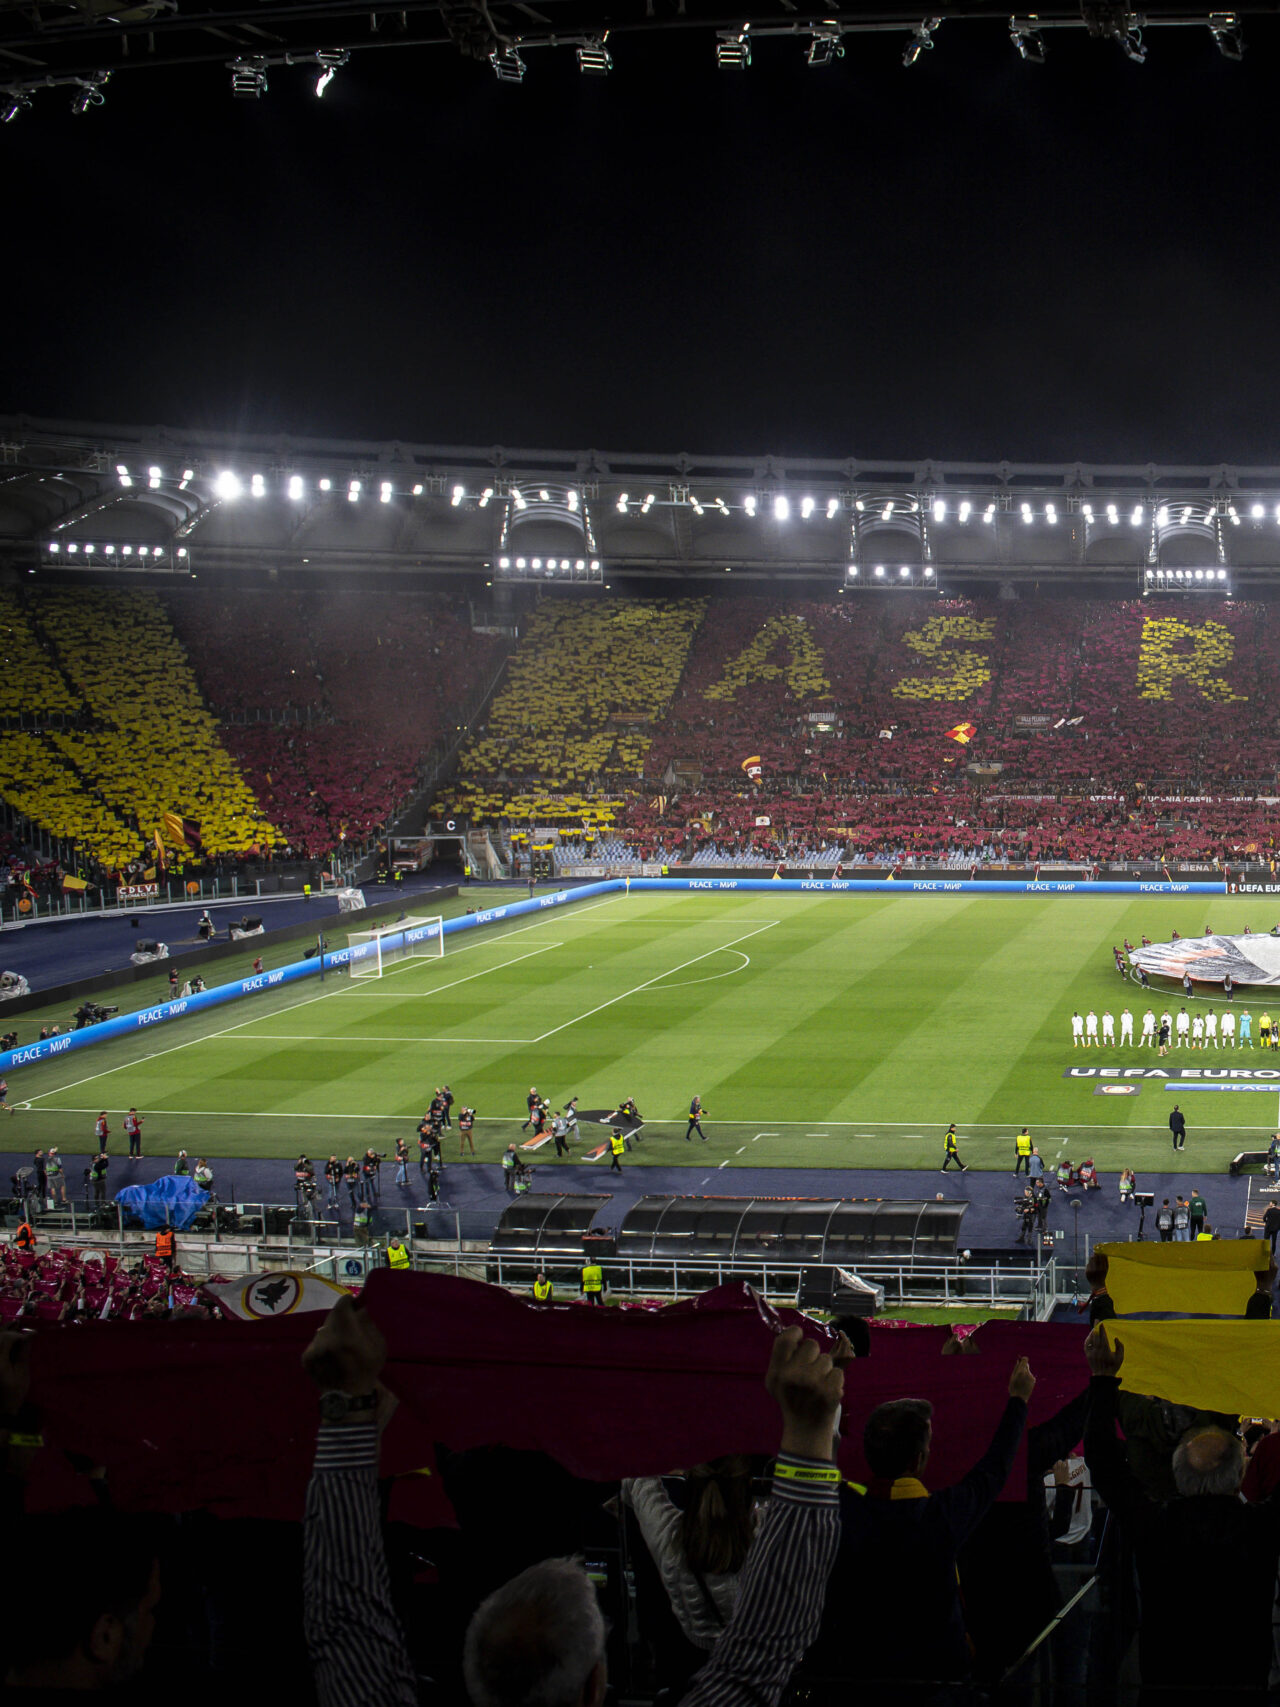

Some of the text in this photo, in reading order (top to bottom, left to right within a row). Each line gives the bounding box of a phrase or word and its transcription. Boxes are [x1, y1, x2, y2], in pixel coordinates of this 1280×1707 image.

[704, 614, 998, 703] AS
[447, 820, 456, 831] C
[690, 881, 713, 889] PEACE
[802, 882, 825, 890] PEACE
[914, 882, 937, 890] PEACE
[1027, 883, 1050, 891] PEACE
[1140, 884, 1163, 892] PEACE
[1239, 884, 1264, 893] UEFA
[331, 951, 350, 965] PEACE
[242, 977, 263, 992] PEACE
[138, 1001, 188, 1025] PEACE МИР
[12, 1037, 72, 1065] PEACE МИР
[1070, 1068, 1170, 1078] UEFA
